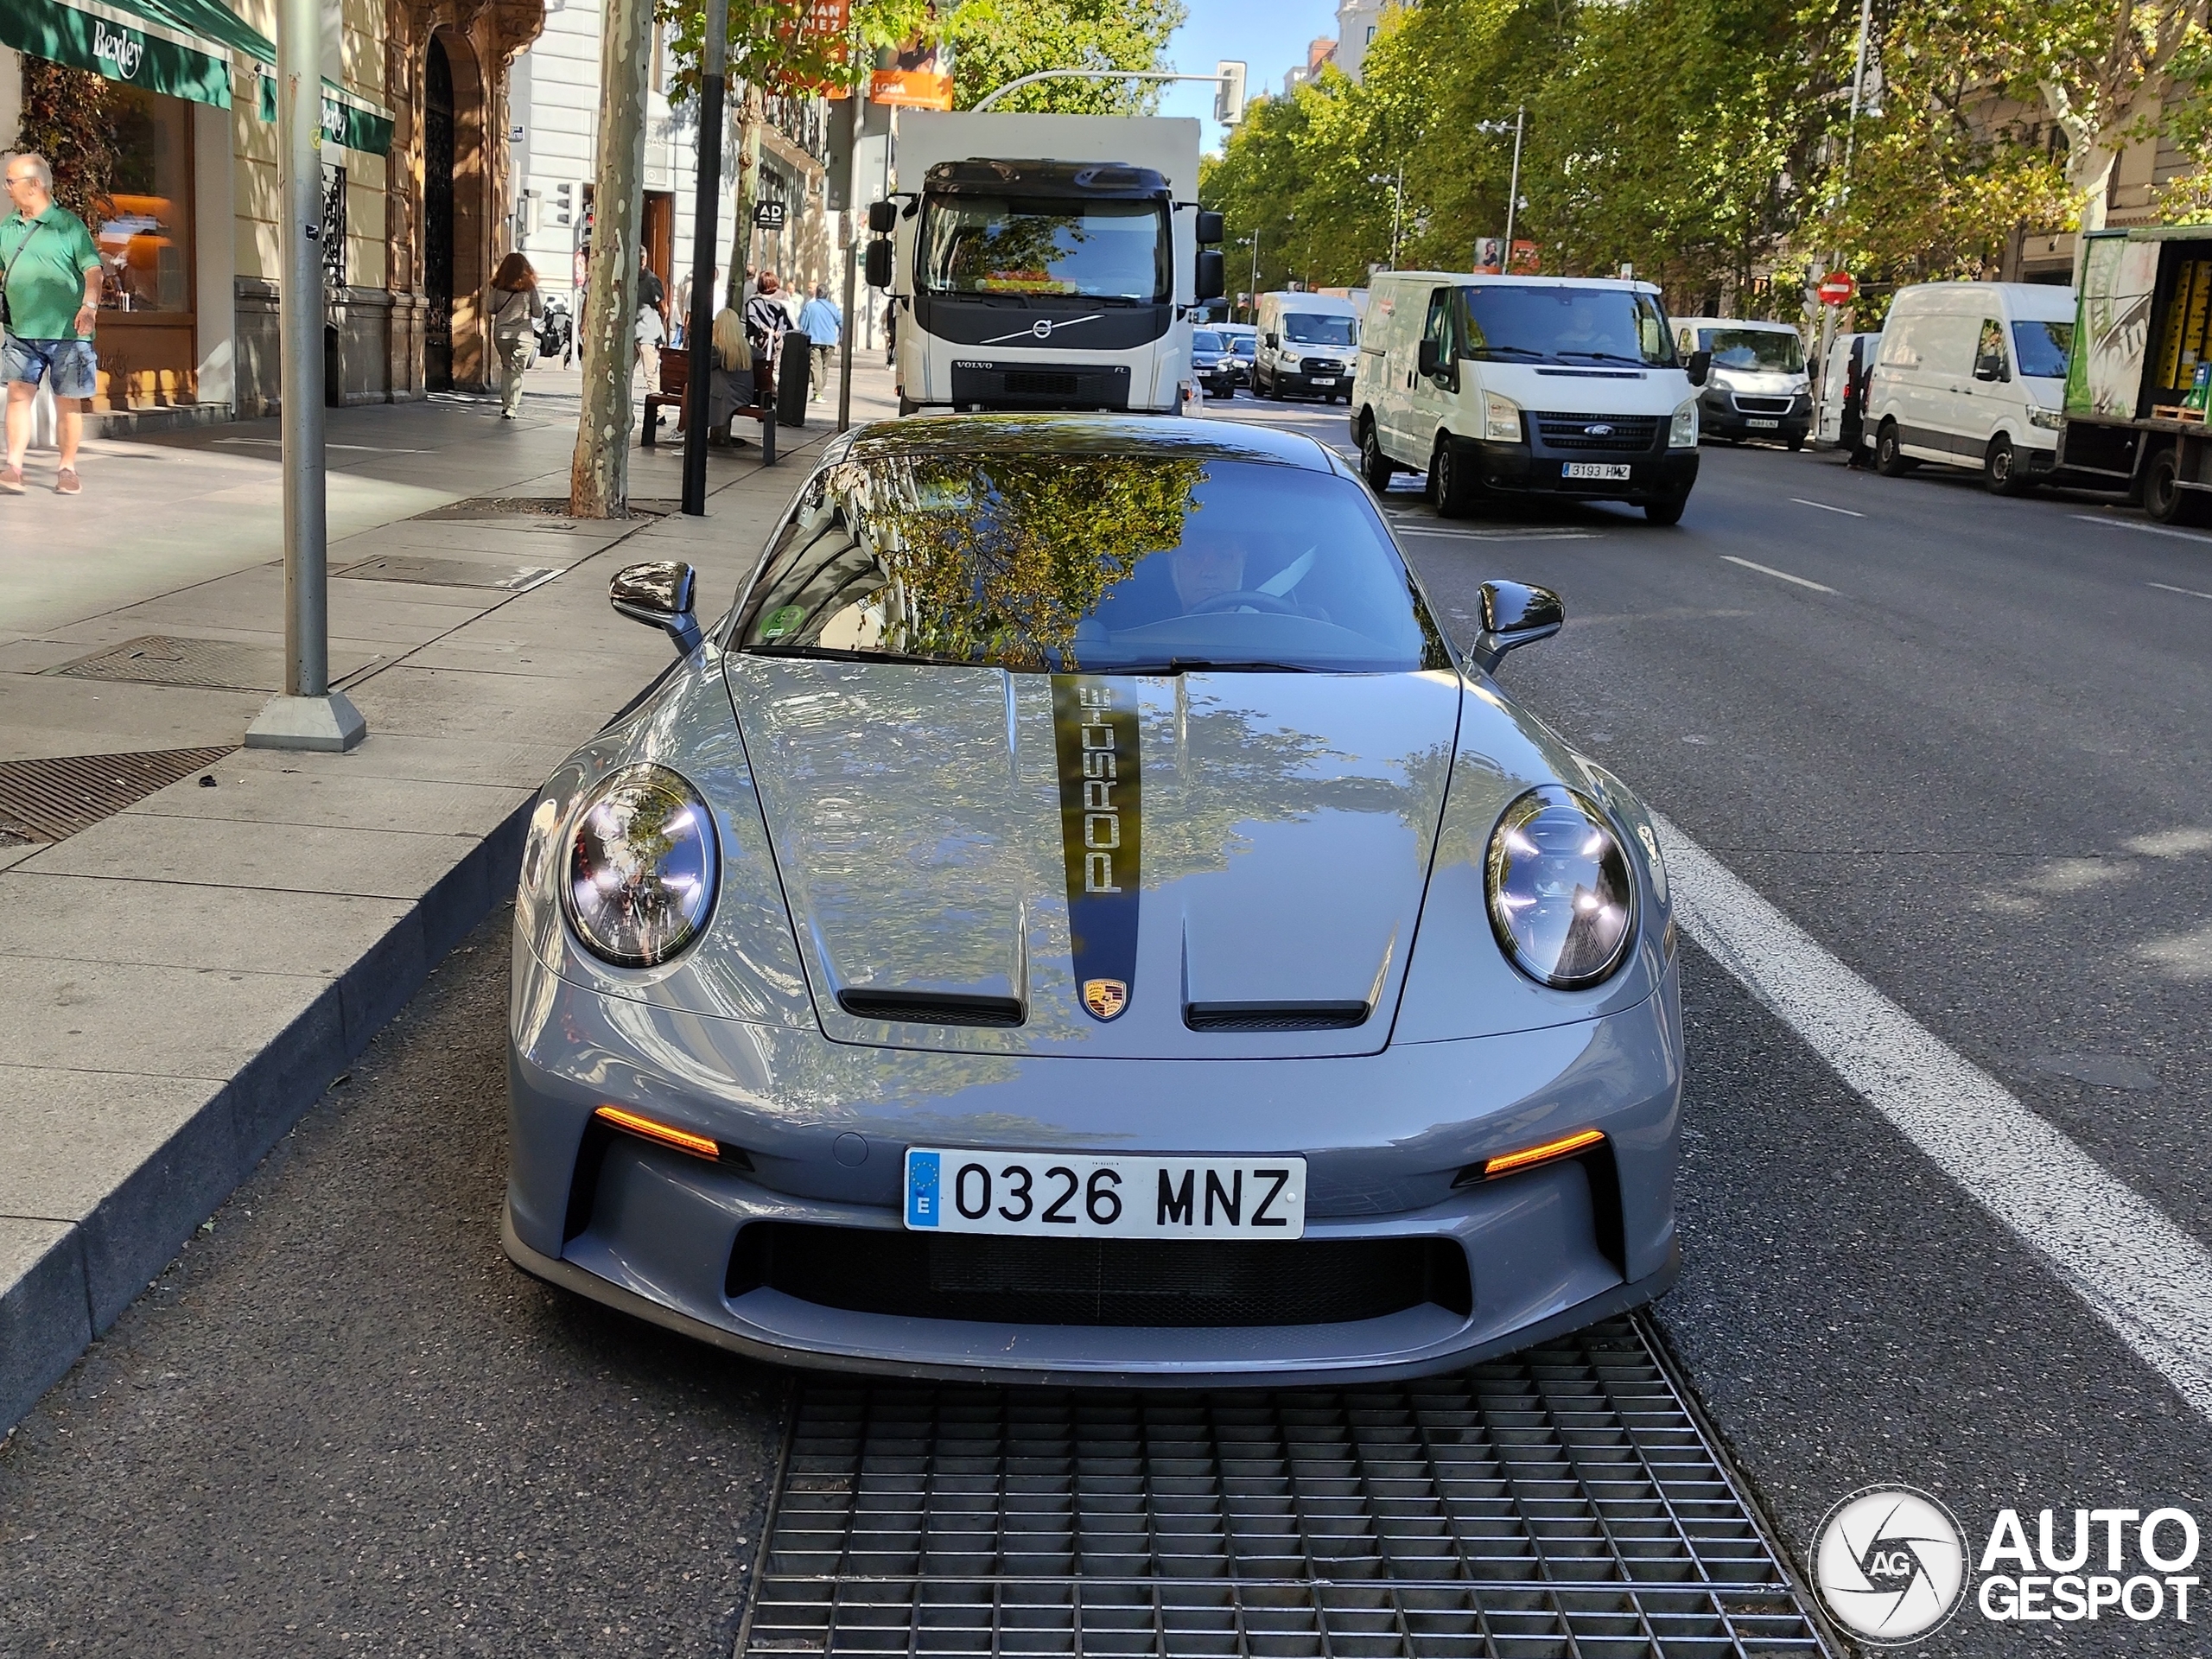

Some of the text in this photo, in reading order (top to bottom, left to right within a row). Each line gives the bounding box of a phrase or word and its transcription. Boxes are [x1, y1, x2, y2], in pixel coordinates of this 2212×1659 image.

[92, 20, 143, 79] Bexley
[875, 82, 906, 94] LOBA
[760, 205, 782, 218] AD
[1573, 466, 1601, 477] 3193
[1079, 687, 1122, 894] PORSCHE
[918, 1162, 1290, 1227] E 0326 MNZ
